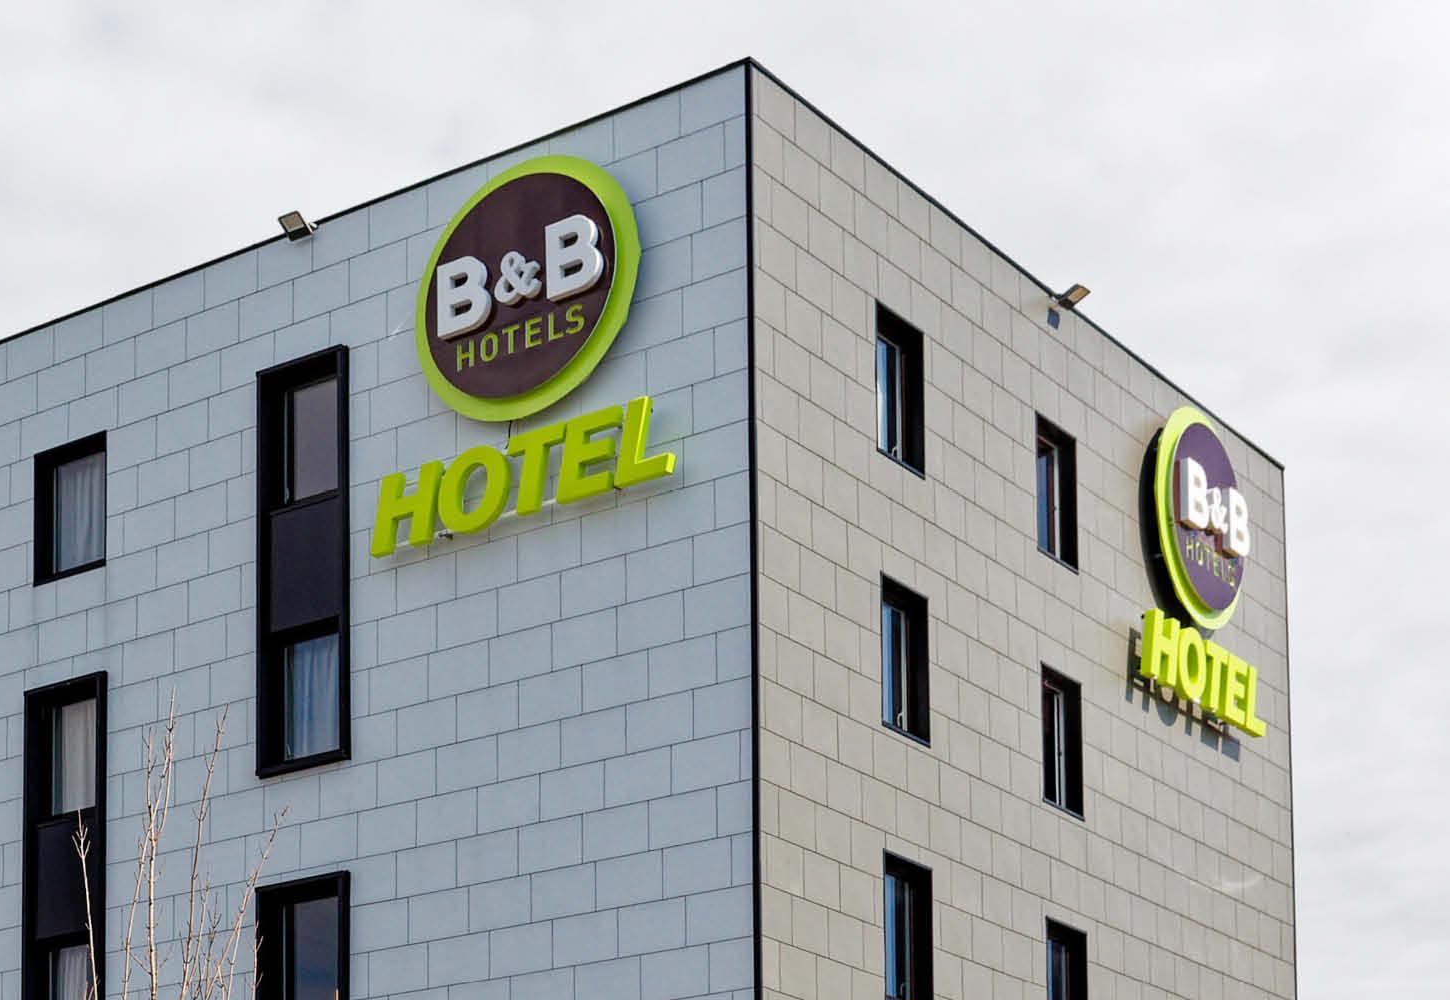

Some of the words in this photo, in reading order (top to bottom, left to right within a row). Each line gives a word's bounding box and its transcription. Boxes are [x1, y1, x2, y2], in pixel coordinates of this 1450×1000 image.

[437, 214, 602, 339] B&B
[456, 304, 586, 371] HOTELS
[370, 396, 677, 559] HOTEL
[1179, 457, 1250, 557] B&B
[1141, 608, 1267, 737] HOTEL
